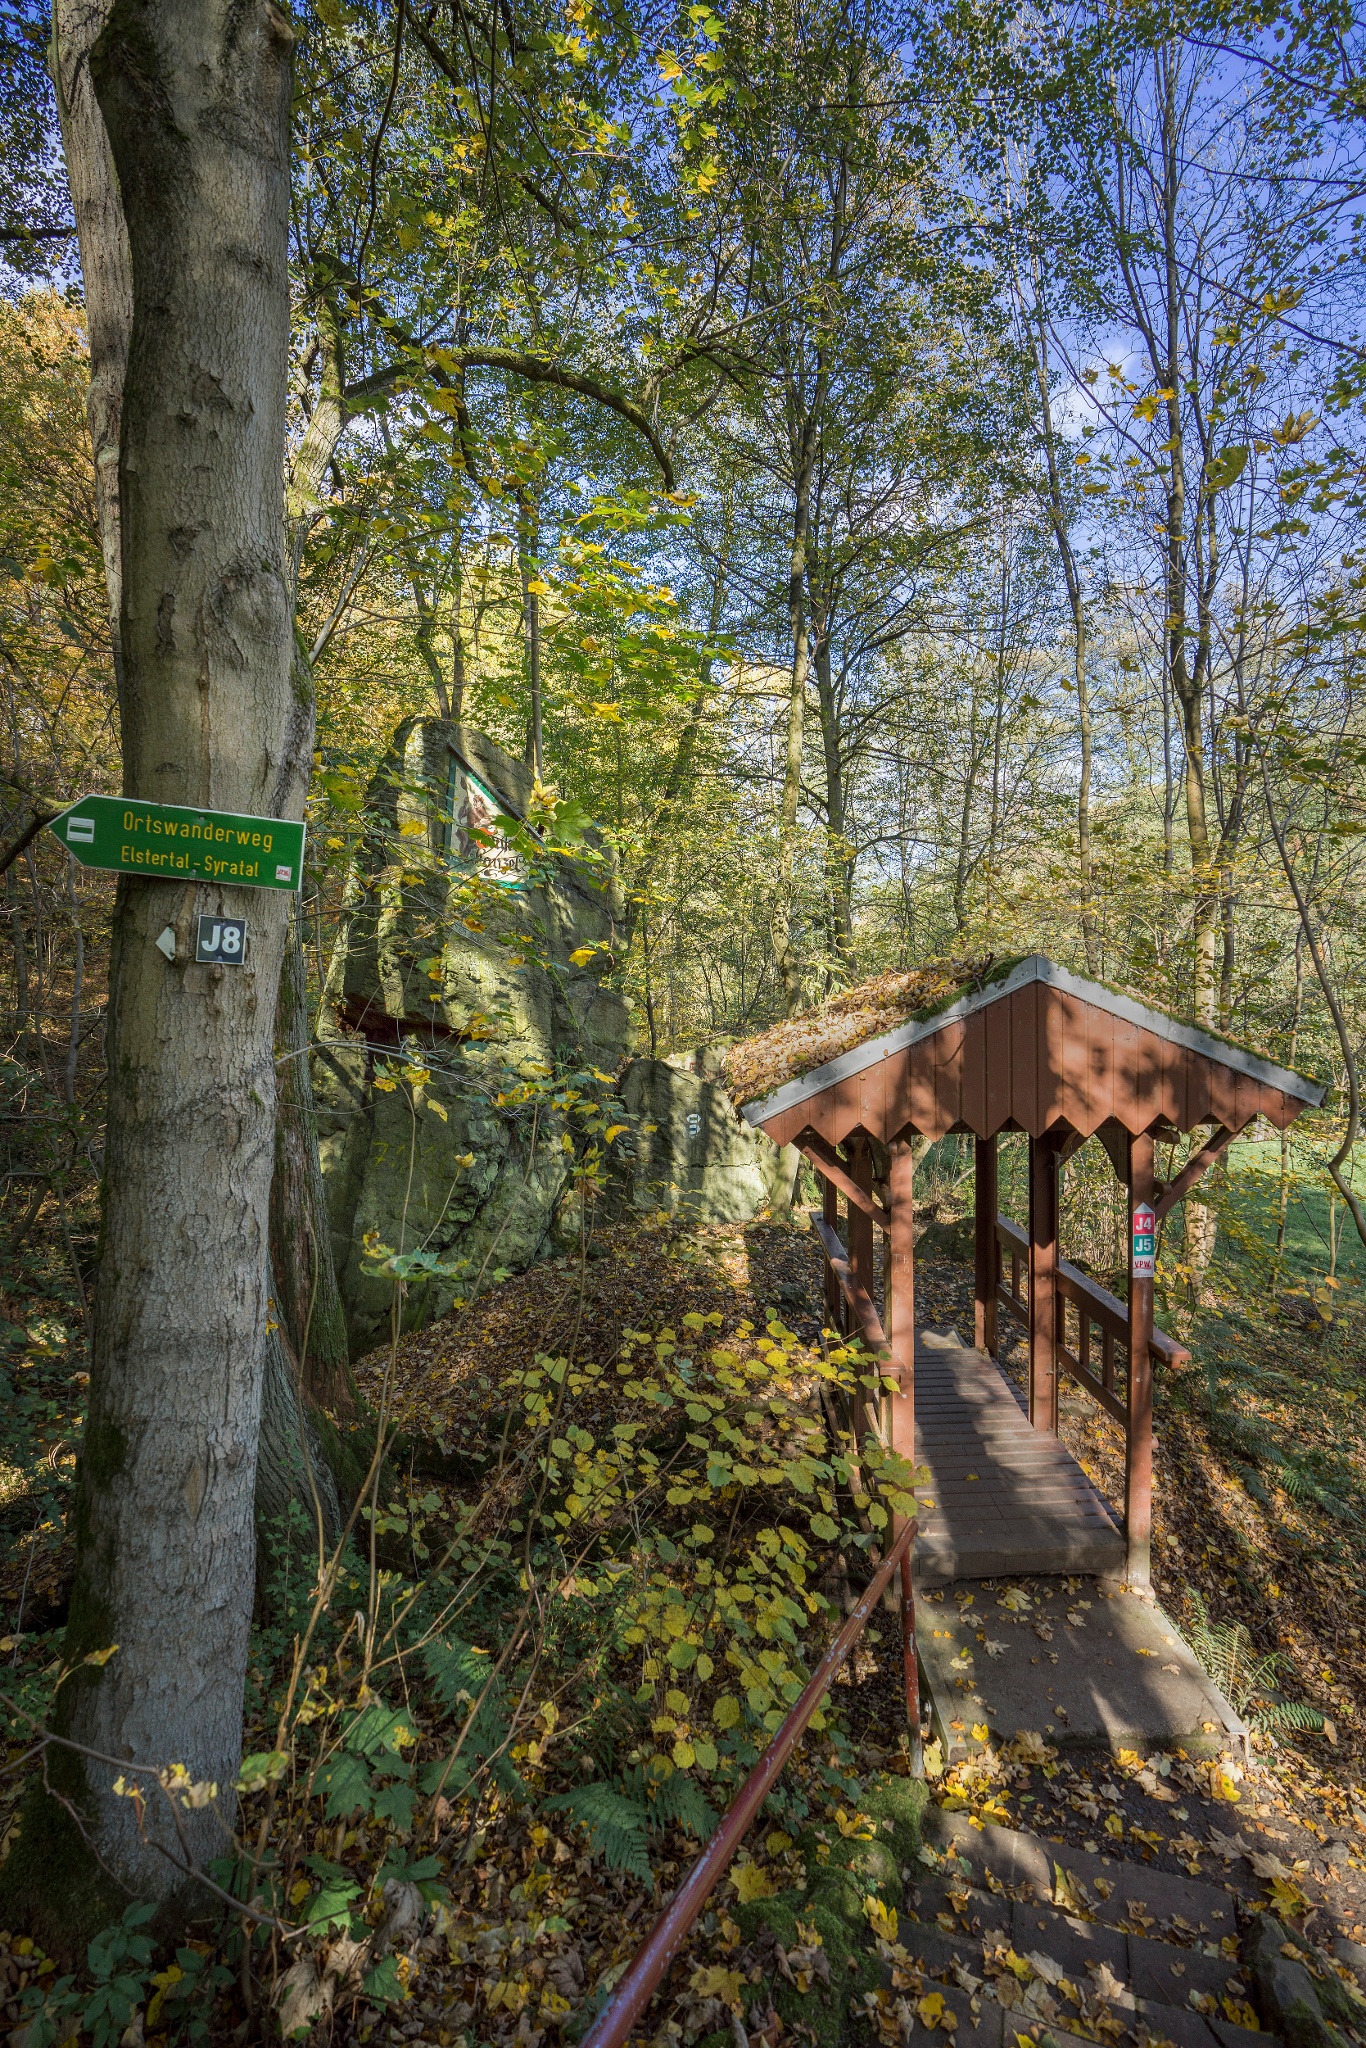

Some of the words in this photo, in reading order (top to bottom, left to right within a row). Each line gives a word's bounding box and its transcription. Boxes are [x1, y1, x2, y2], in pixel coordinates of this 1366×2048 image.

[123, 811, 273, 852] Ortswanderweg
[121, 846, 190, 870] Elstertal
[204, 854, 259, 878] Syratal
[201, 925, 241, 954] J8
[1135, 1217, 1152, 1230] J4
[1135, 1238, 1152, 1252] J5
